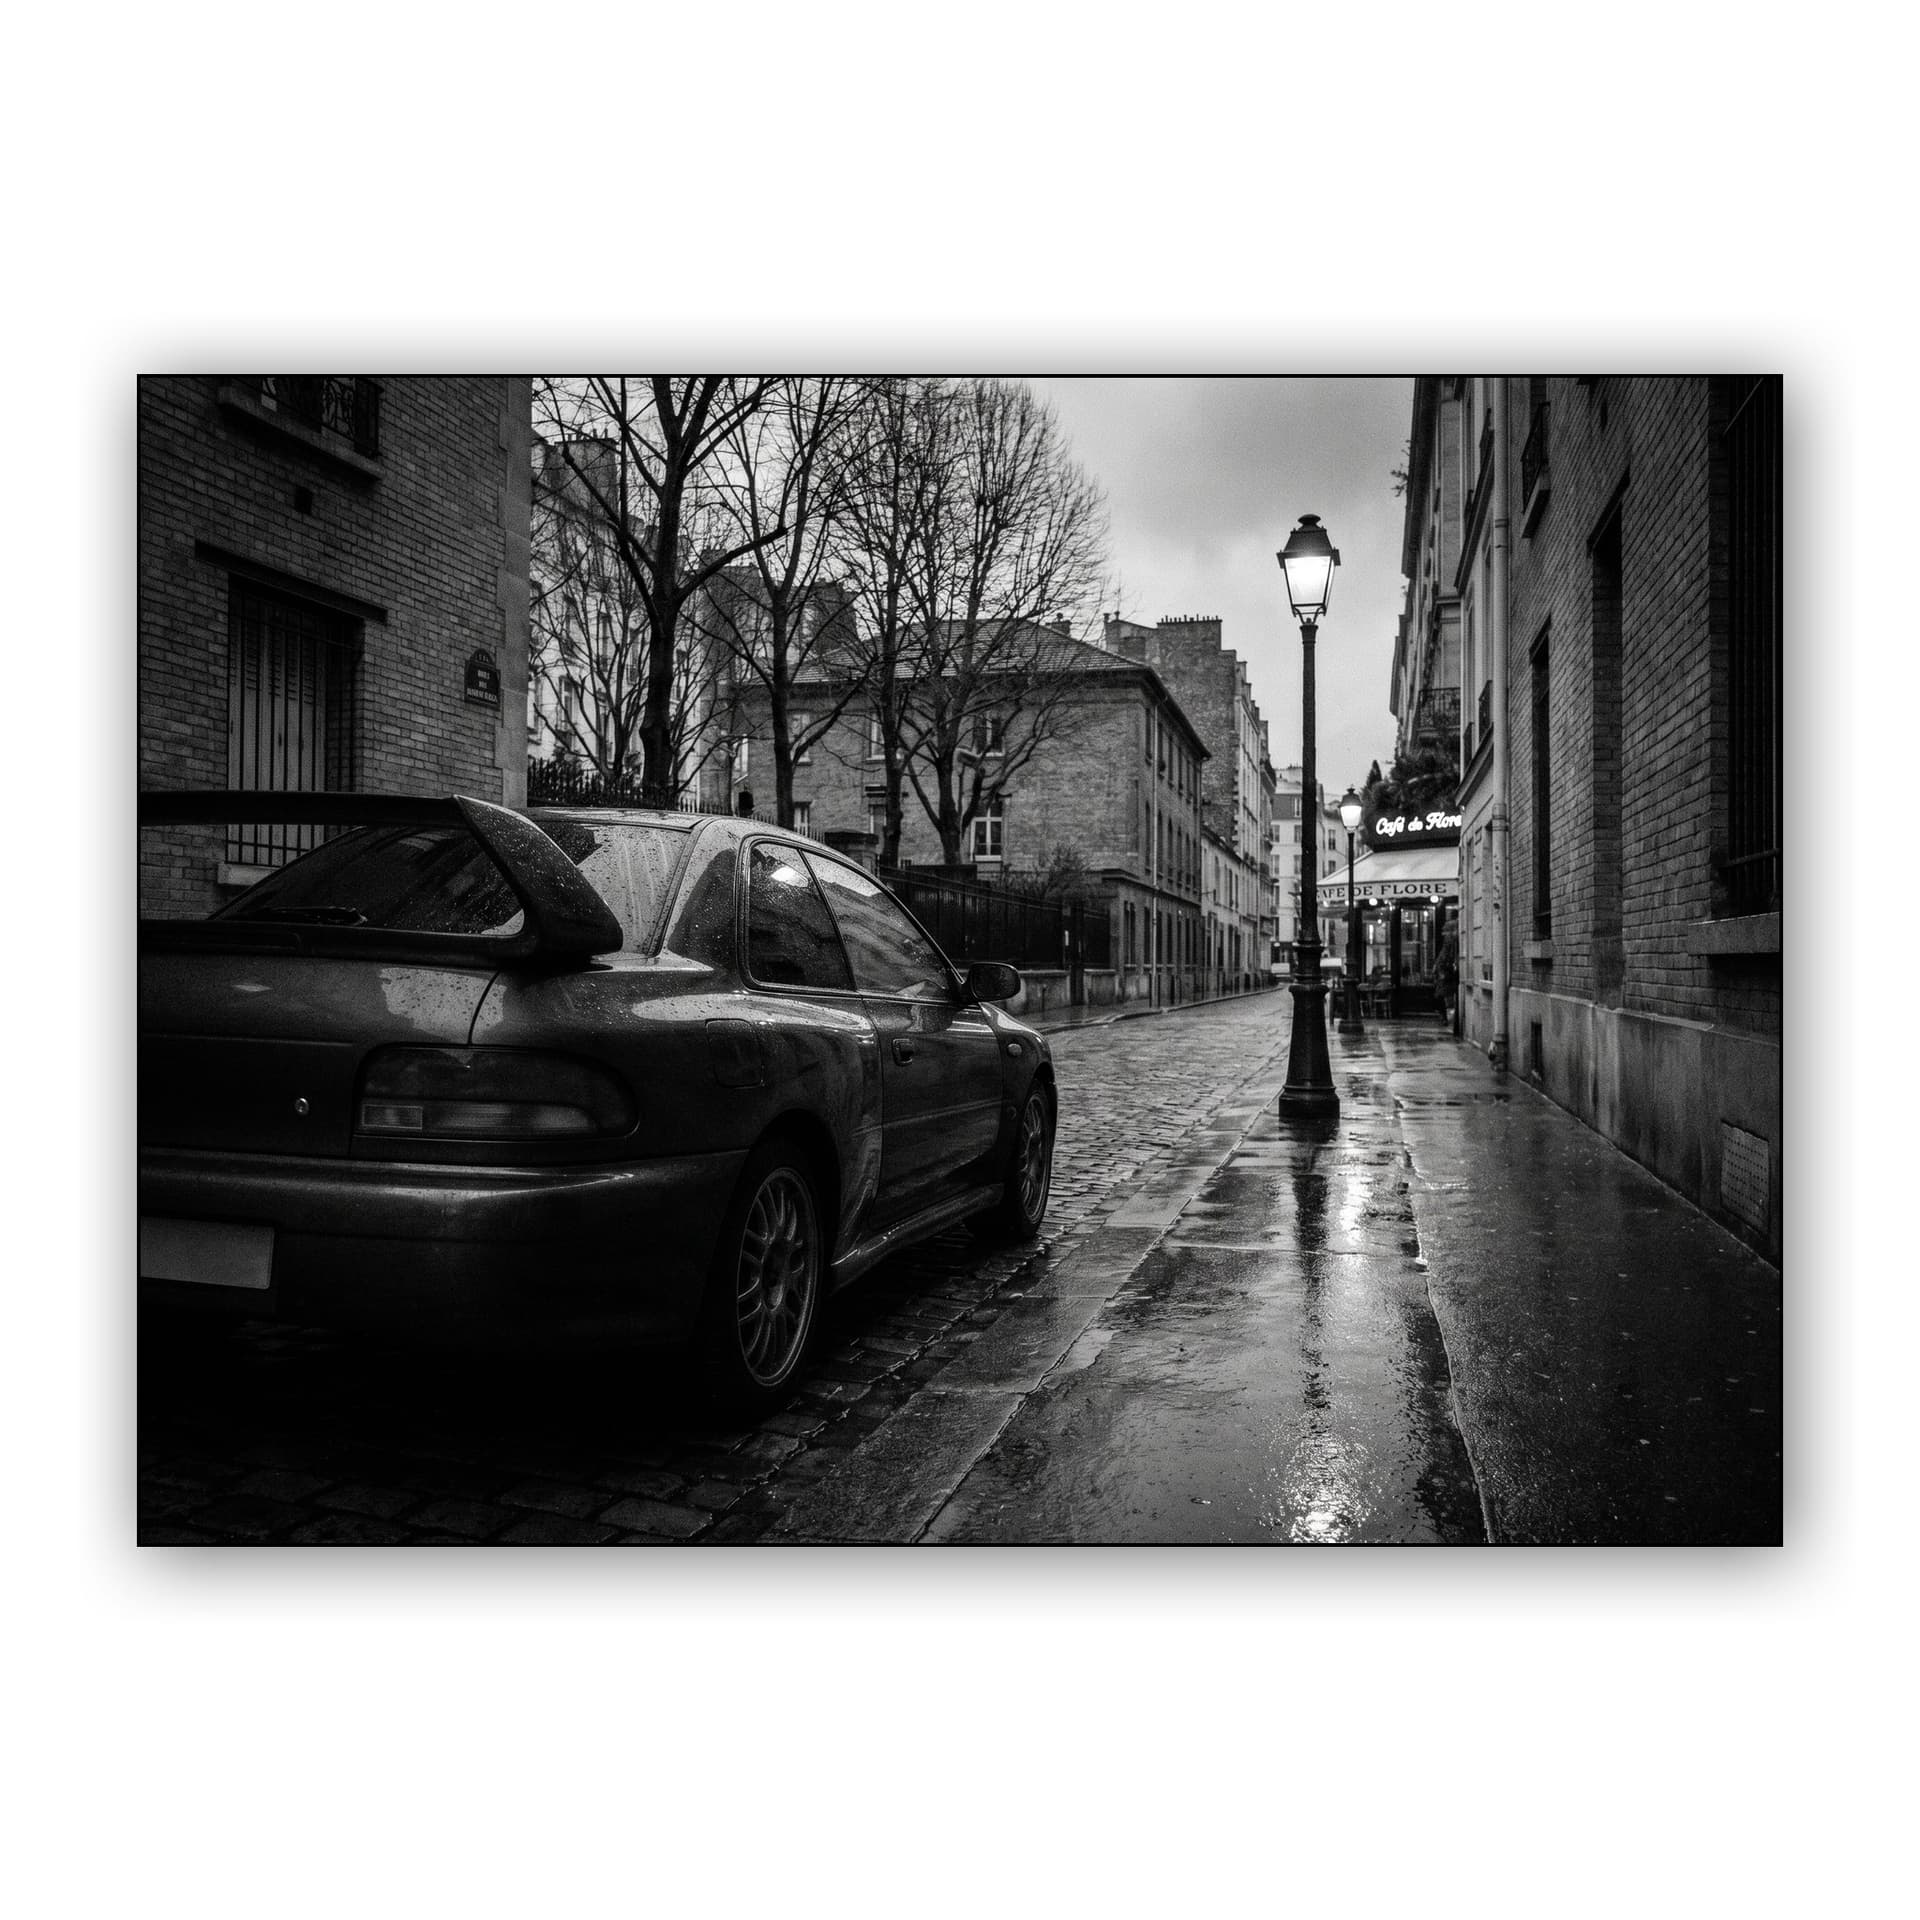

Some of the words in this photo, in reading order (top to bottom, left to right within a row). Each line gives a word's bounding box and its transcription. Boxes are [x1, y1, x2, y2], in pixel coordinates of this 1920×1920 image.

[1375, 816, 1405, 837] Café
[1407, 816, 1423, 832] de
[1425, 811, 1462, 831] Flore
[1353, 885, 1373, 897] DE
[1380, 883, 1447, 895] FLORE
